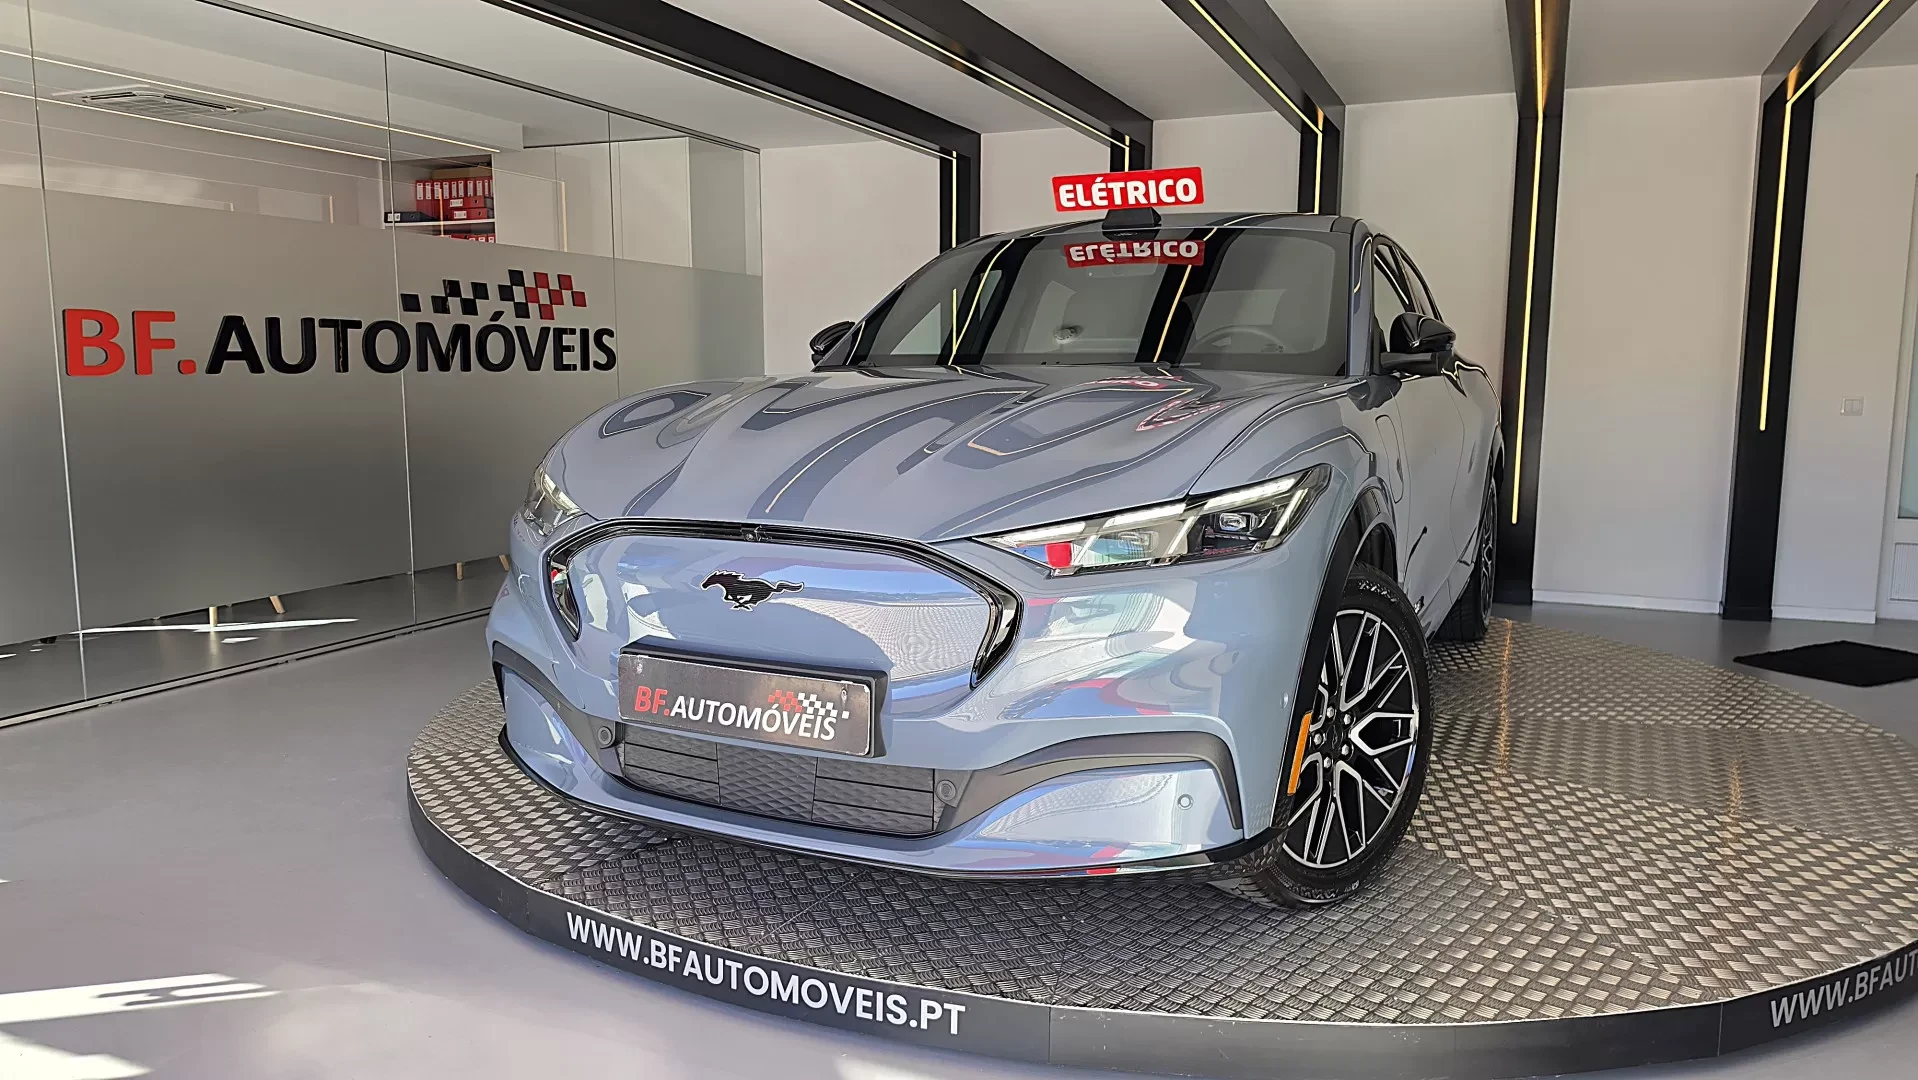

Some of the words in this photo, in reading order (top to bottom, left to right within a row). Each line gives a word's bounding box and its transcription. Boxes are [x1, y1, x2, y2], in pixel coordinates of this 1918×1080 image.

[1058, 177, 1198, 208] ELÉTRICO
[567, 911, 966, 1035] WWW.BFAUTOMOVEIS.PT
[1770, 948, 1918, 1028] WWW.BFAUT
